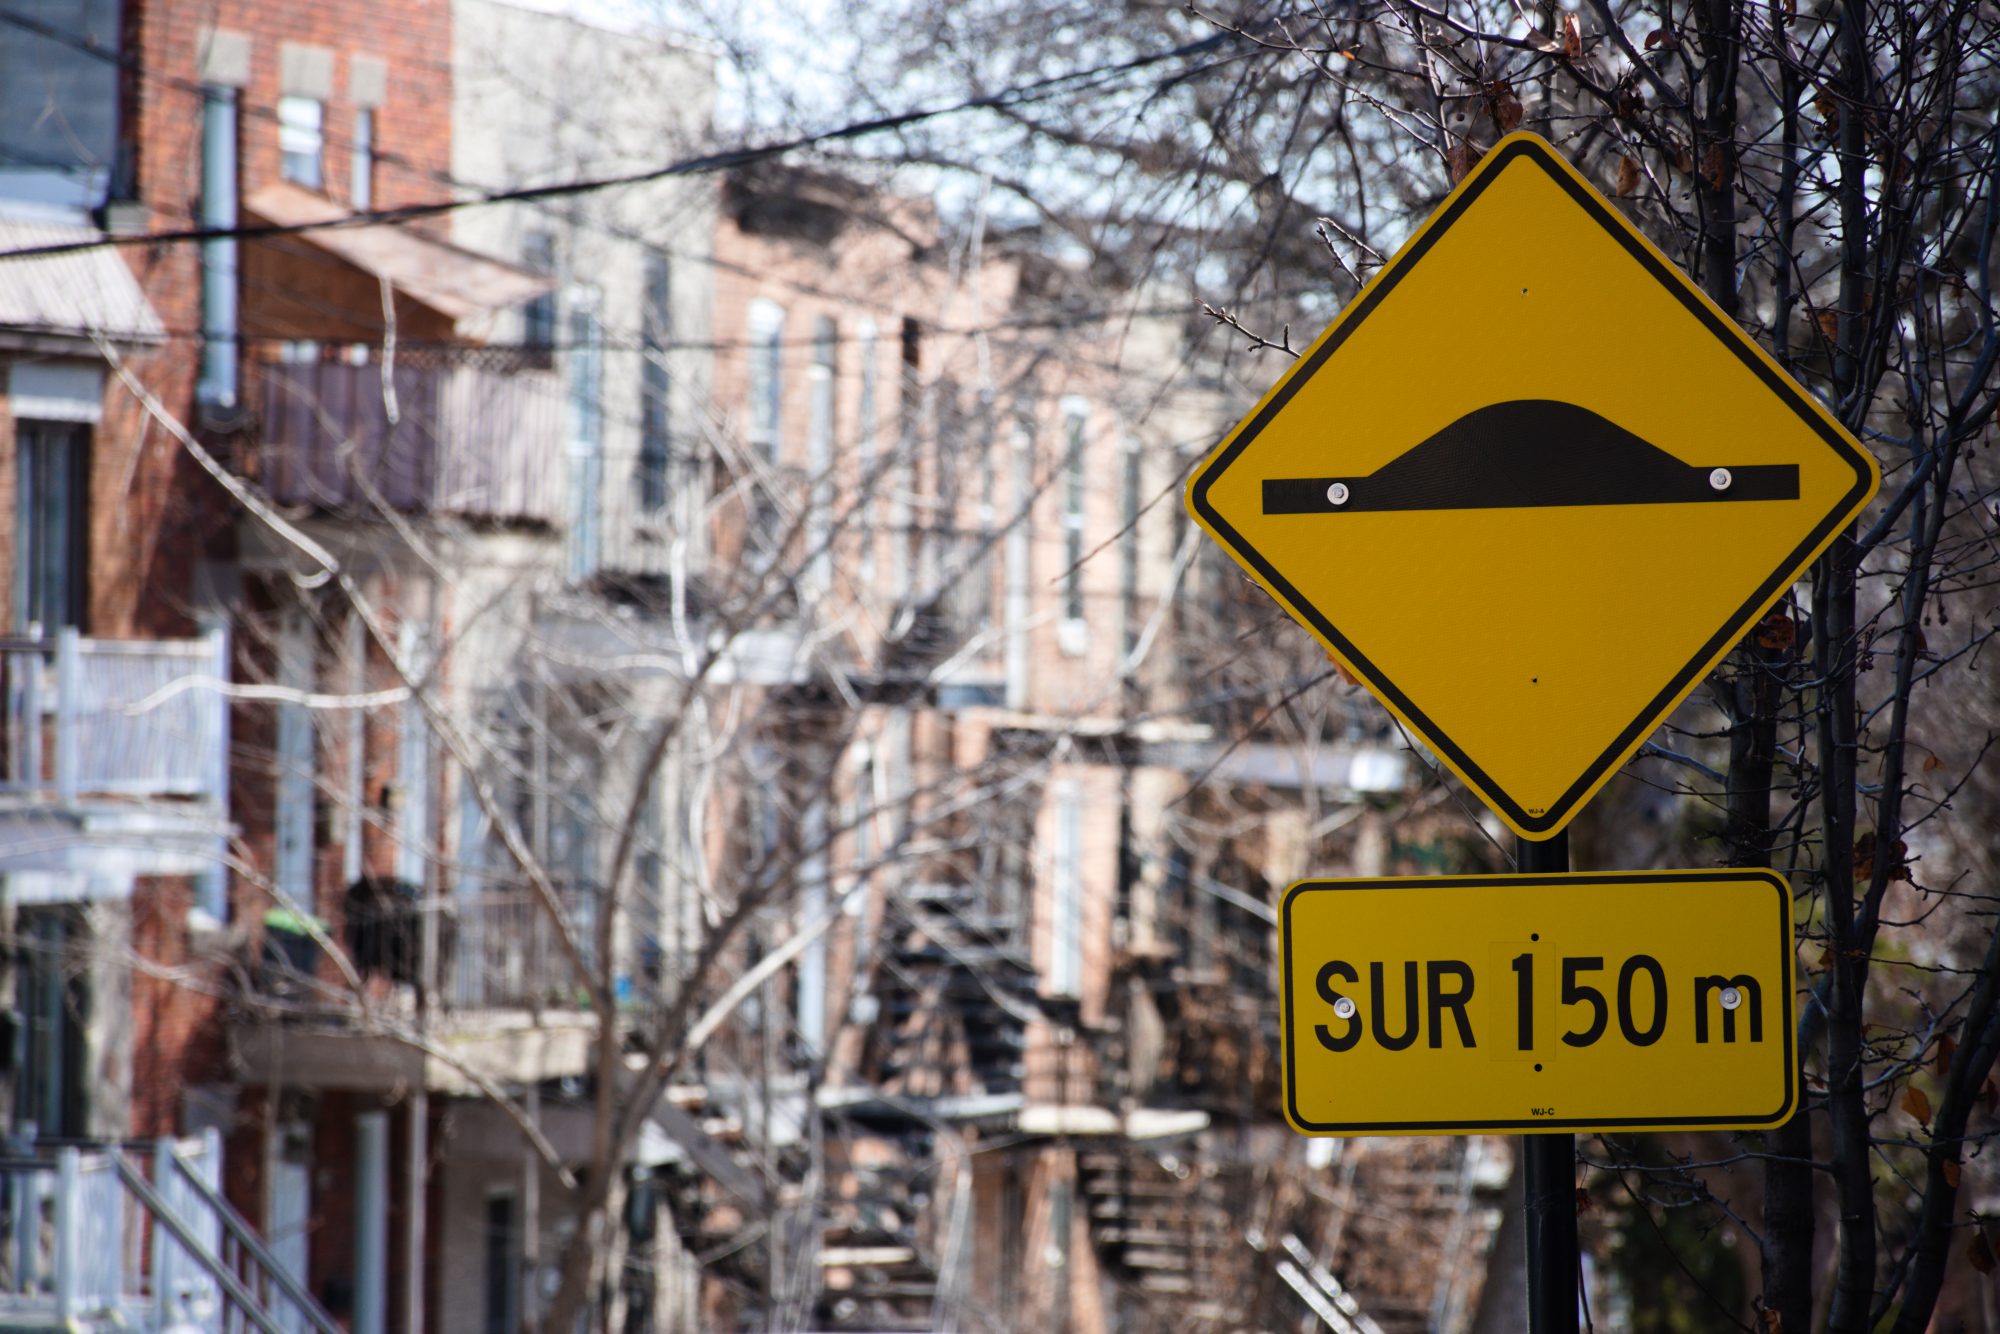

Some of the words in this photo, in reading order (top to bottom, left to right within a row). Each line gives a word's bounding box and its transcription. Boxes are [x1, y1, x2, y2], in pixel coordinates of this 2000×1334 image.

[1314, 959, 1477, 1053] SUR
[1511, 953, 1669, 1051] 150
[1694, 973, 1763, 1044] m
[1531, 1107, 1555, 1116] WJ-C
